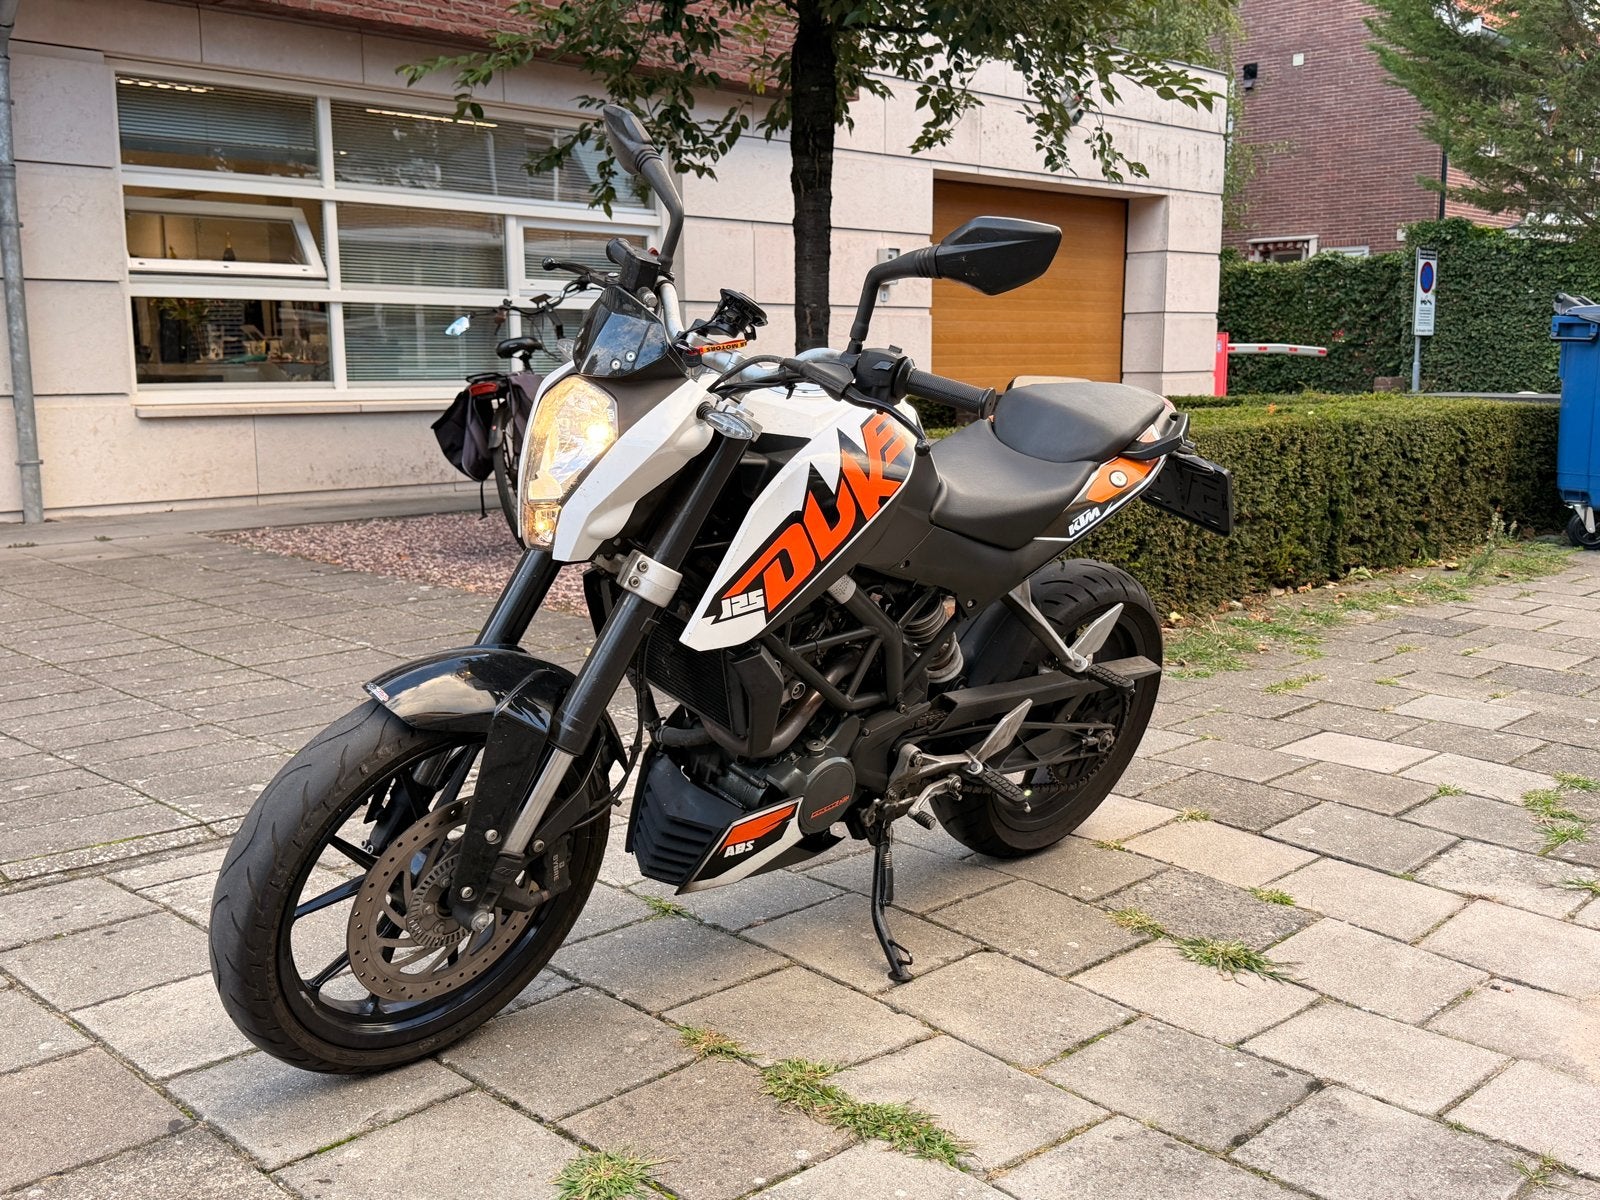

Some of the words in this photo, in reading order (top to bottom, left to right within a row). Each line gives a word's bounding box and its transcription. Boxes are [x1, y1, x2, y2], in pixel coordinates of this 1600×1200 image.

[706, 343, 738, 352] MOTORS
[723, 411, 906, 612] DUKE
[1068, 507, 1101, 536] KTM
[720, 589, 765, 619] 125
[723, 840, 755, 858] ABS
